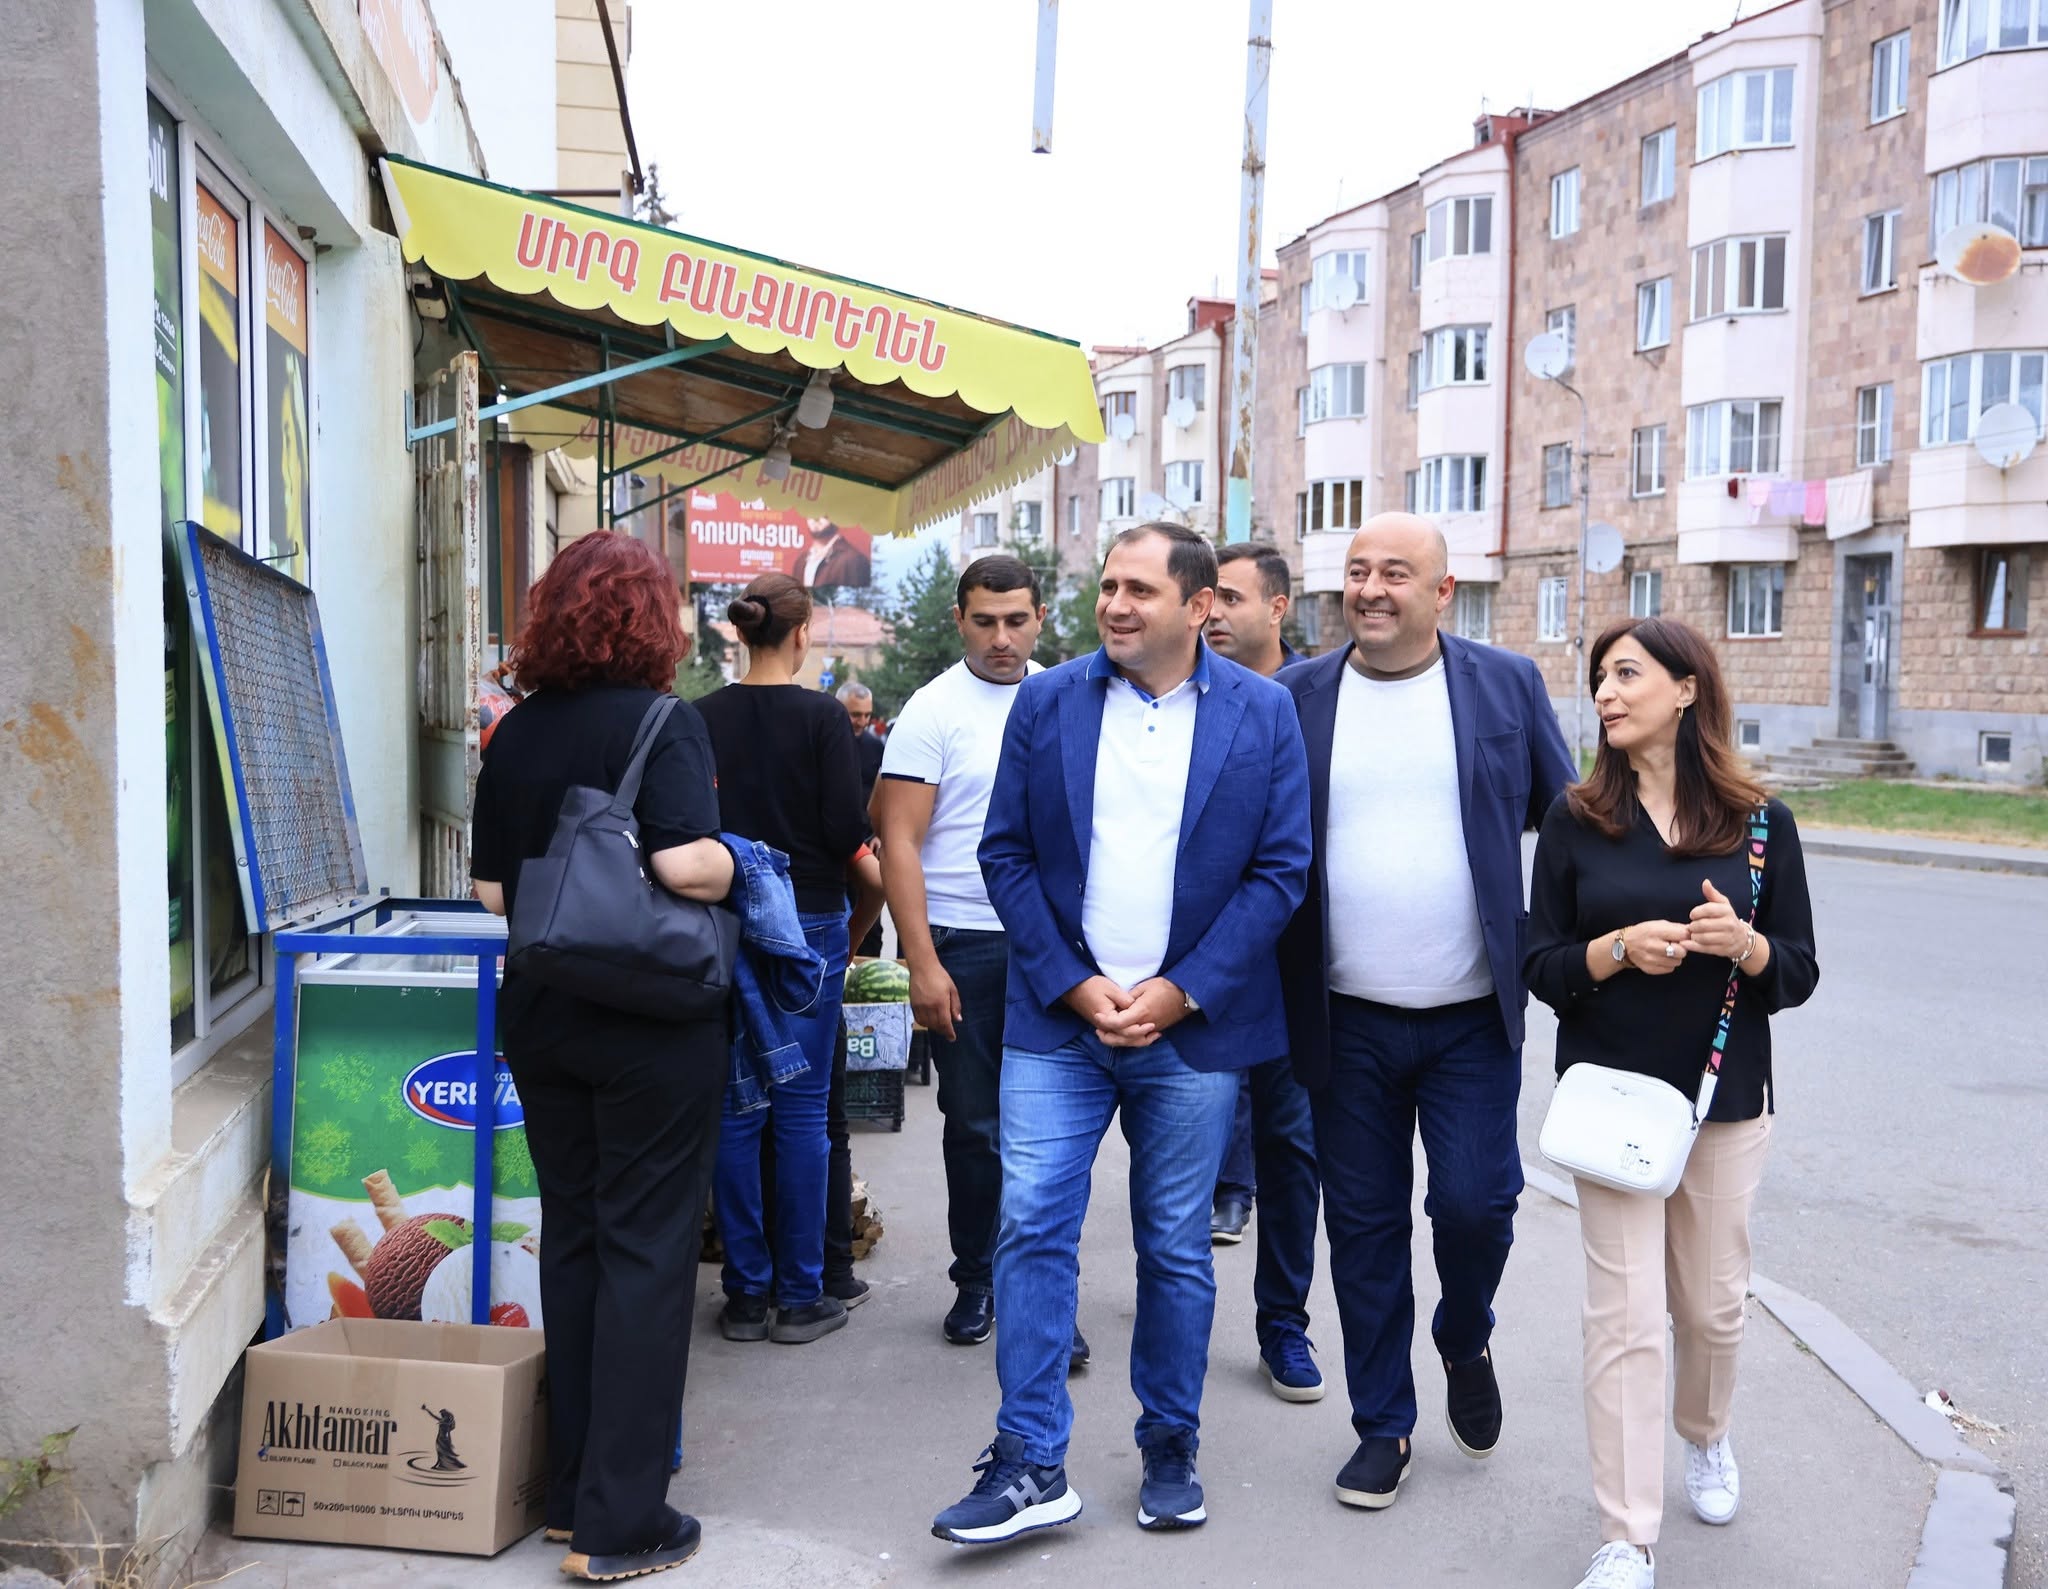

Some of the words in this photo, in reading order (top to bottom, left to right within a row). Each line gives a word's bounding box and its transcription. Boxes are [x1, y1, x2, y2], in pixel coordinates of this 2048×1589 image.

[517, 213, 640, 293] ՄԻՐԳ
[658, 252, 948, 372] ԲԱՆՋԱՐԵՂԵՆ
[690, 519, 805, 548] ԴՈՒՄԻԿՅԱՆ
[329, 1406, 391, 1418] NANOKING
[261, 1400, 398, 1456] Akhtamar
[269, 1455, 292, 1463] SILVER
[293, 1456, 316, 1464] FLAME
[342, 1460, 365, 1469] BLACK
[366, 1462, 389, 1470] FLAME
